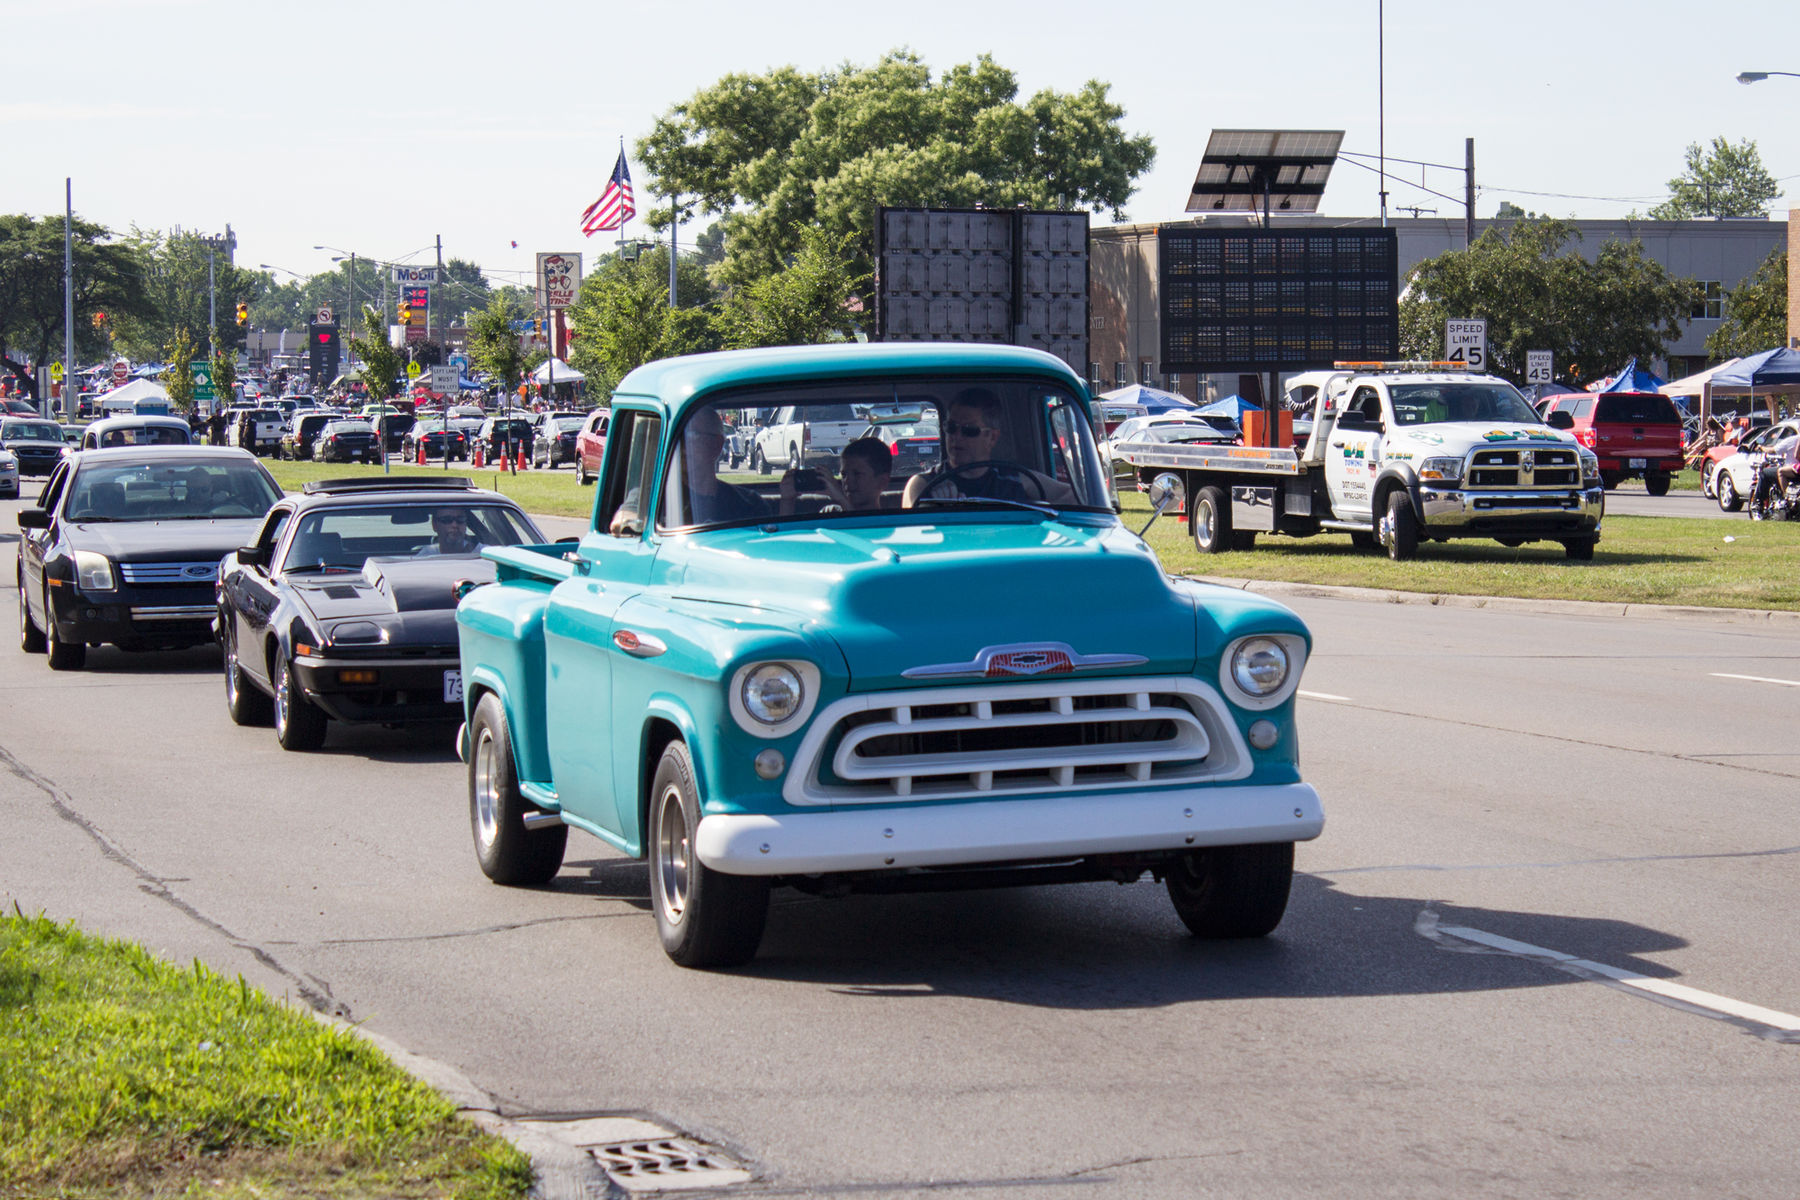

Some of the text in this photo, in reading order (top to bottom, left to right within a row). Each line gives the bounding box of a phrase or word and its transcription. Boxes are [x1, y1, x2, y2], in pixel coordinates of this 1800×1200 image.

[397, 268, 434, 281] Mobil
[1449, 324, 1483, 333] SPEED
[1452, 335, 1479, 344] LIMIT
[1449, 347, 1482, 366] 45
[1528, 368, 1550, 380] 45
